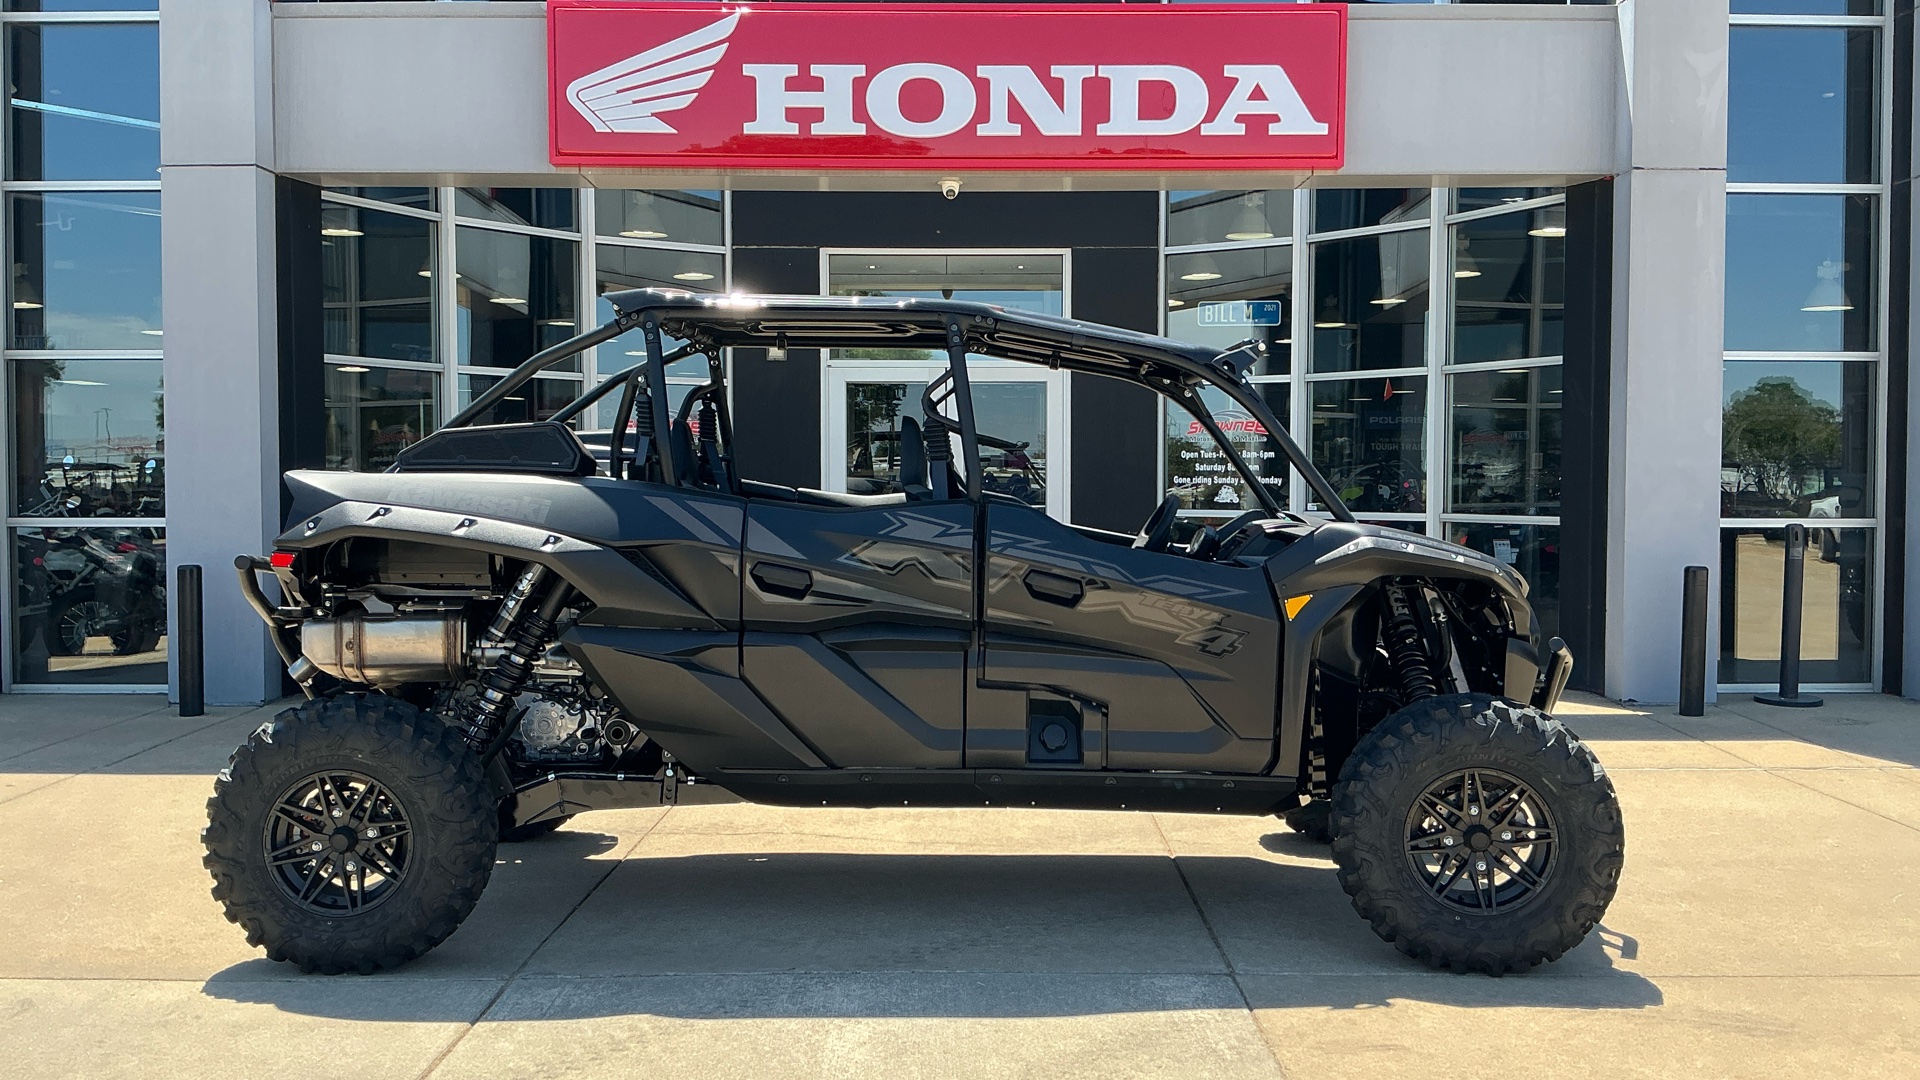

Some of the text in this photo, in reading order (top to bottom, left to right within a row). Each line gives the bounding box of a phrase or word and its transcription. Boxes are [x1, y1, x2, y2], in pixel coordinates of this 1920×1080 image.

[742, 62, 1329, 138] HONDA
[1204, 305, 1236, 322] BILL
[1371, 443, 1398, 451] TOUGH
[1181, 451, 1198, 460] Open
[1242, 450, 1275, 460] 8am-6pm
[1195, 463, 1225, 473] Saturday
[1173, 476, 1191, 485] Gone
[1192, 476, 1211, 486] riding
[1213, 476, 1238, 486] Sunday
[387, 485, 552, 524] Kawasaki
[1179, 626, 1245, 657] 4
